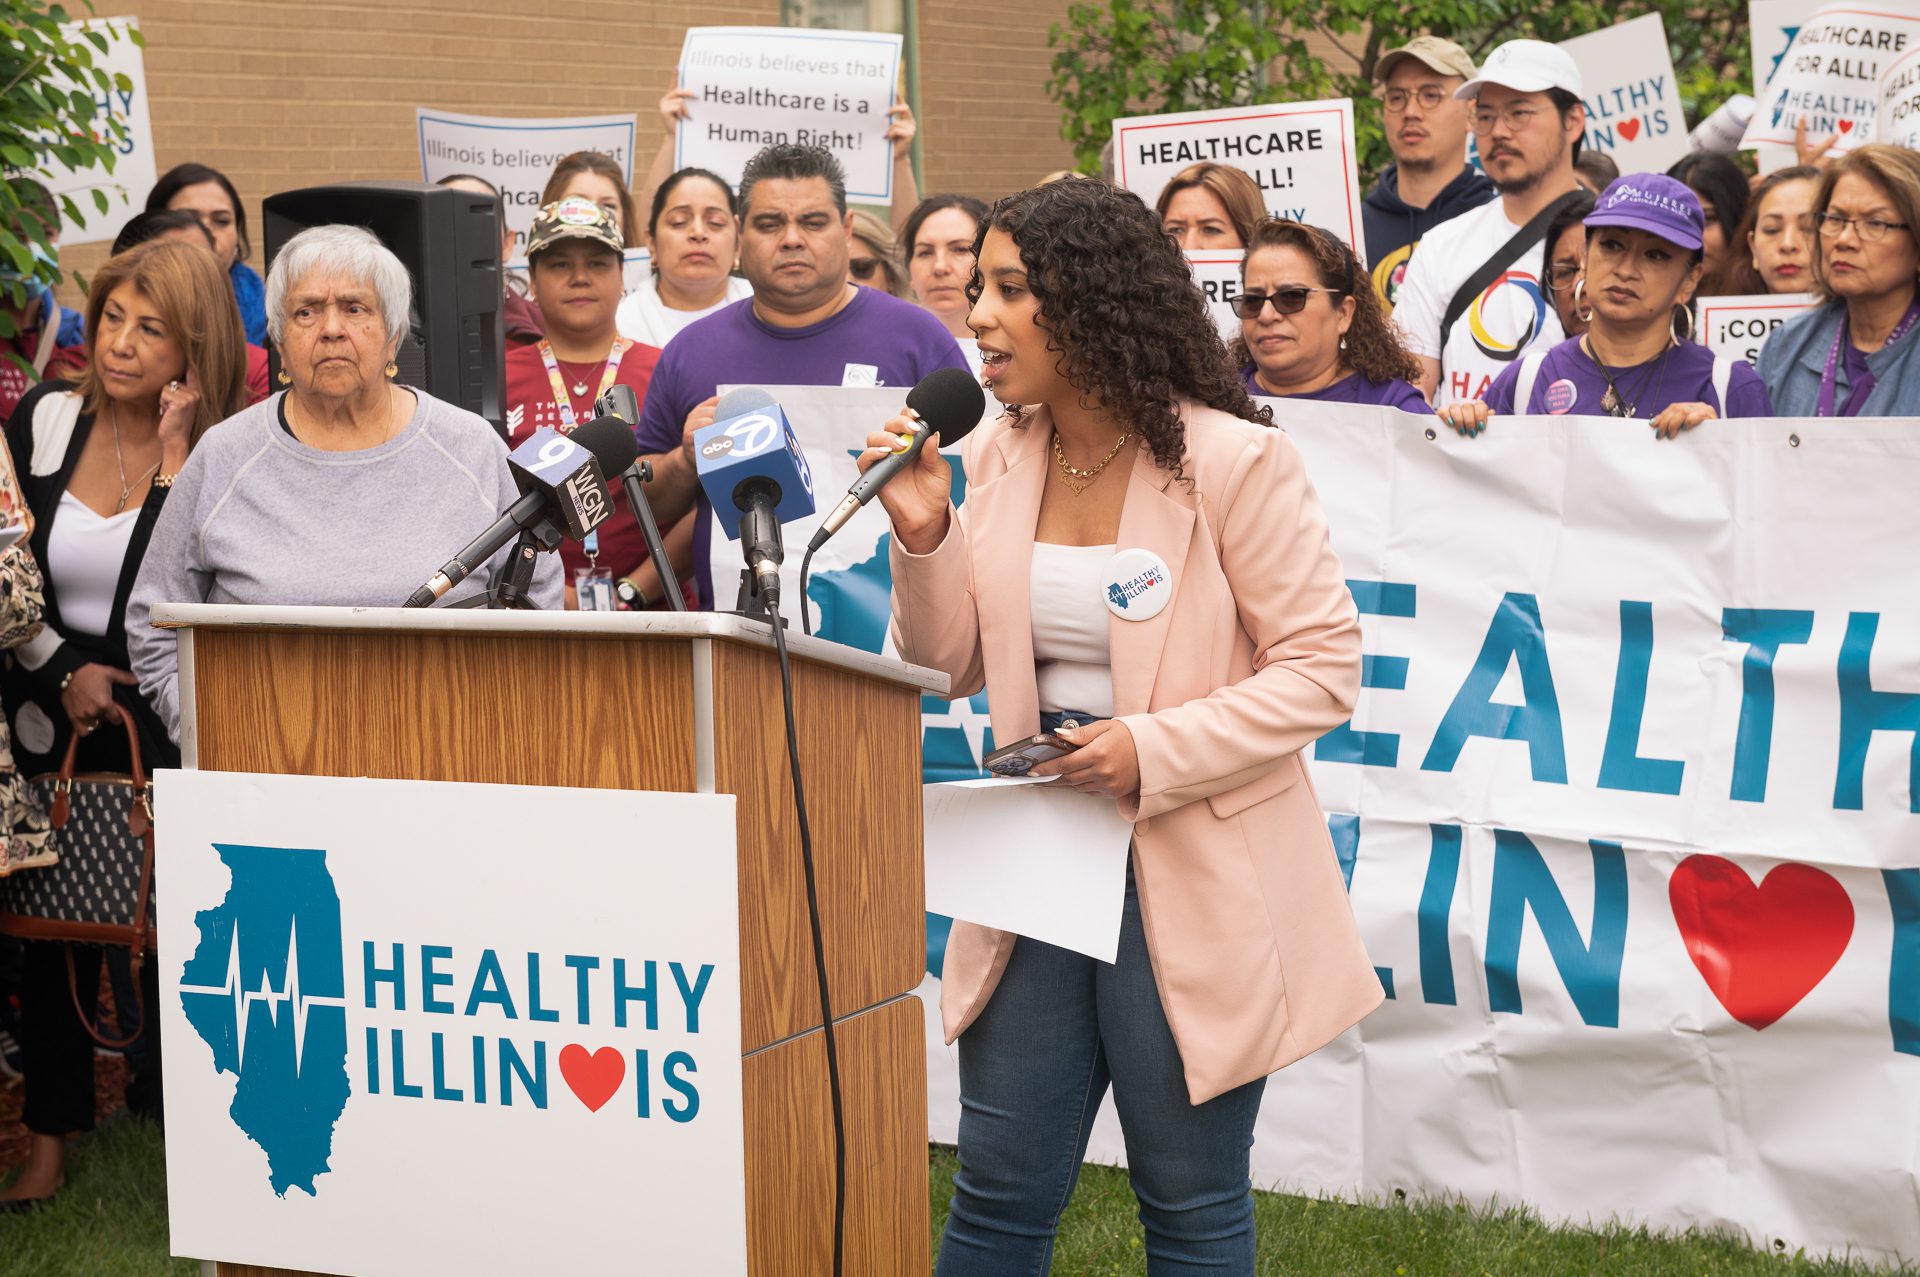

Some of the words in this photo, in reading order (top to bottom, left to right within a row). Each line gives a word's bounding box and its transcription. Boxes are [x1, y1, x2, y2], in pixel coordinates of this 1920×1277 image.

[690, 50, 752, 69] Illinois
[759, 53, 839, 75] believes
[846, 60, 886, 78] that
[1827, 58, 1877, 80] ALL!
[703, 84, 825, 111] Healthcare
[834, 93, 850, 112] is
[858, 98, 869, 114] a
[1583, 75, 1664, 121] ALTHY
[1791, 91, 1877, 117] HEALTHY
[708, 123, 788, 144] Human
[797, 128, 863, 151] Right!
[1140, 129, 1323, 165] HEALTHCARE
[426, 139, 486, 165] Illinois
[1256, 167, 1294, 191] LL!
[1452, 371, 1492, 400] HA
[703, 440, 733, 455] abc
[728, 417, 774, 455] 7
[525, 436, 576, 473] 9
[573, 496, 585, 516] NEWS
[574, 465, 608, 528] WGN
[1122, 565, 1160, 592] HEALTHY
[1315, 579, 1920, 814] EALTH
[363, 941, 715, 1034] HEALTHY
